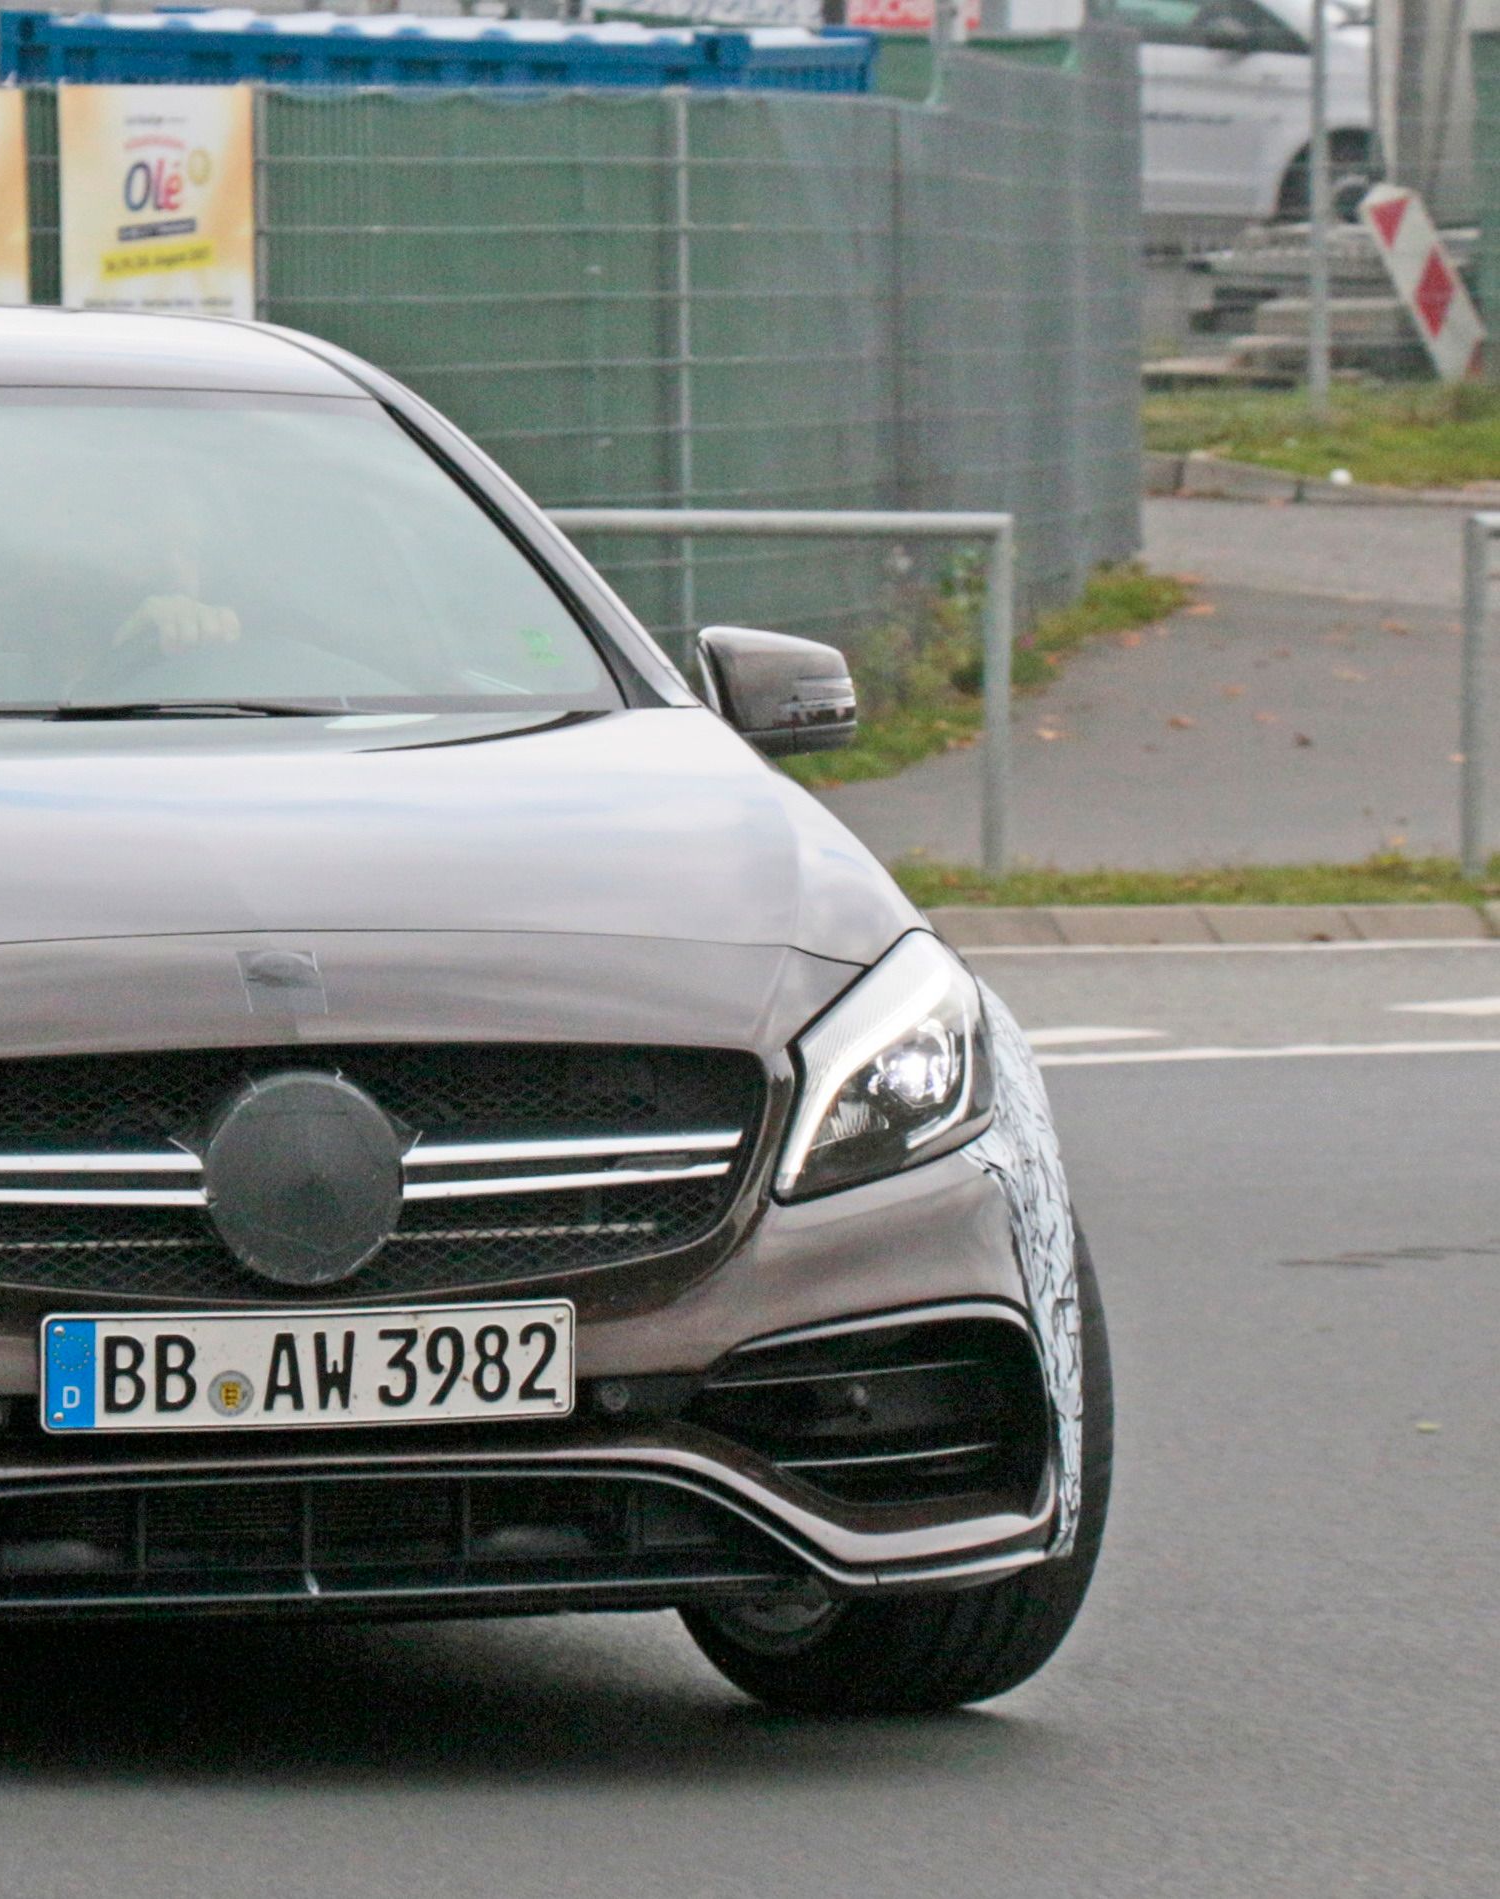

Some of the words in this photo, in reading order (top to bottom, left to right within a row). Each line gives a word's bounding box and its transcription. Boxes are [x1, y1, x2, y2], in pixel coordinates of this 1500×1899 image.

[123, 158, 184, 213] Olé
[104, 1335, 197, 1413] BB
[263, 1331, 355, 1411] AW
[378, 1321, 557, 1407] 3982
[62, 1386, 81, 1409] D
